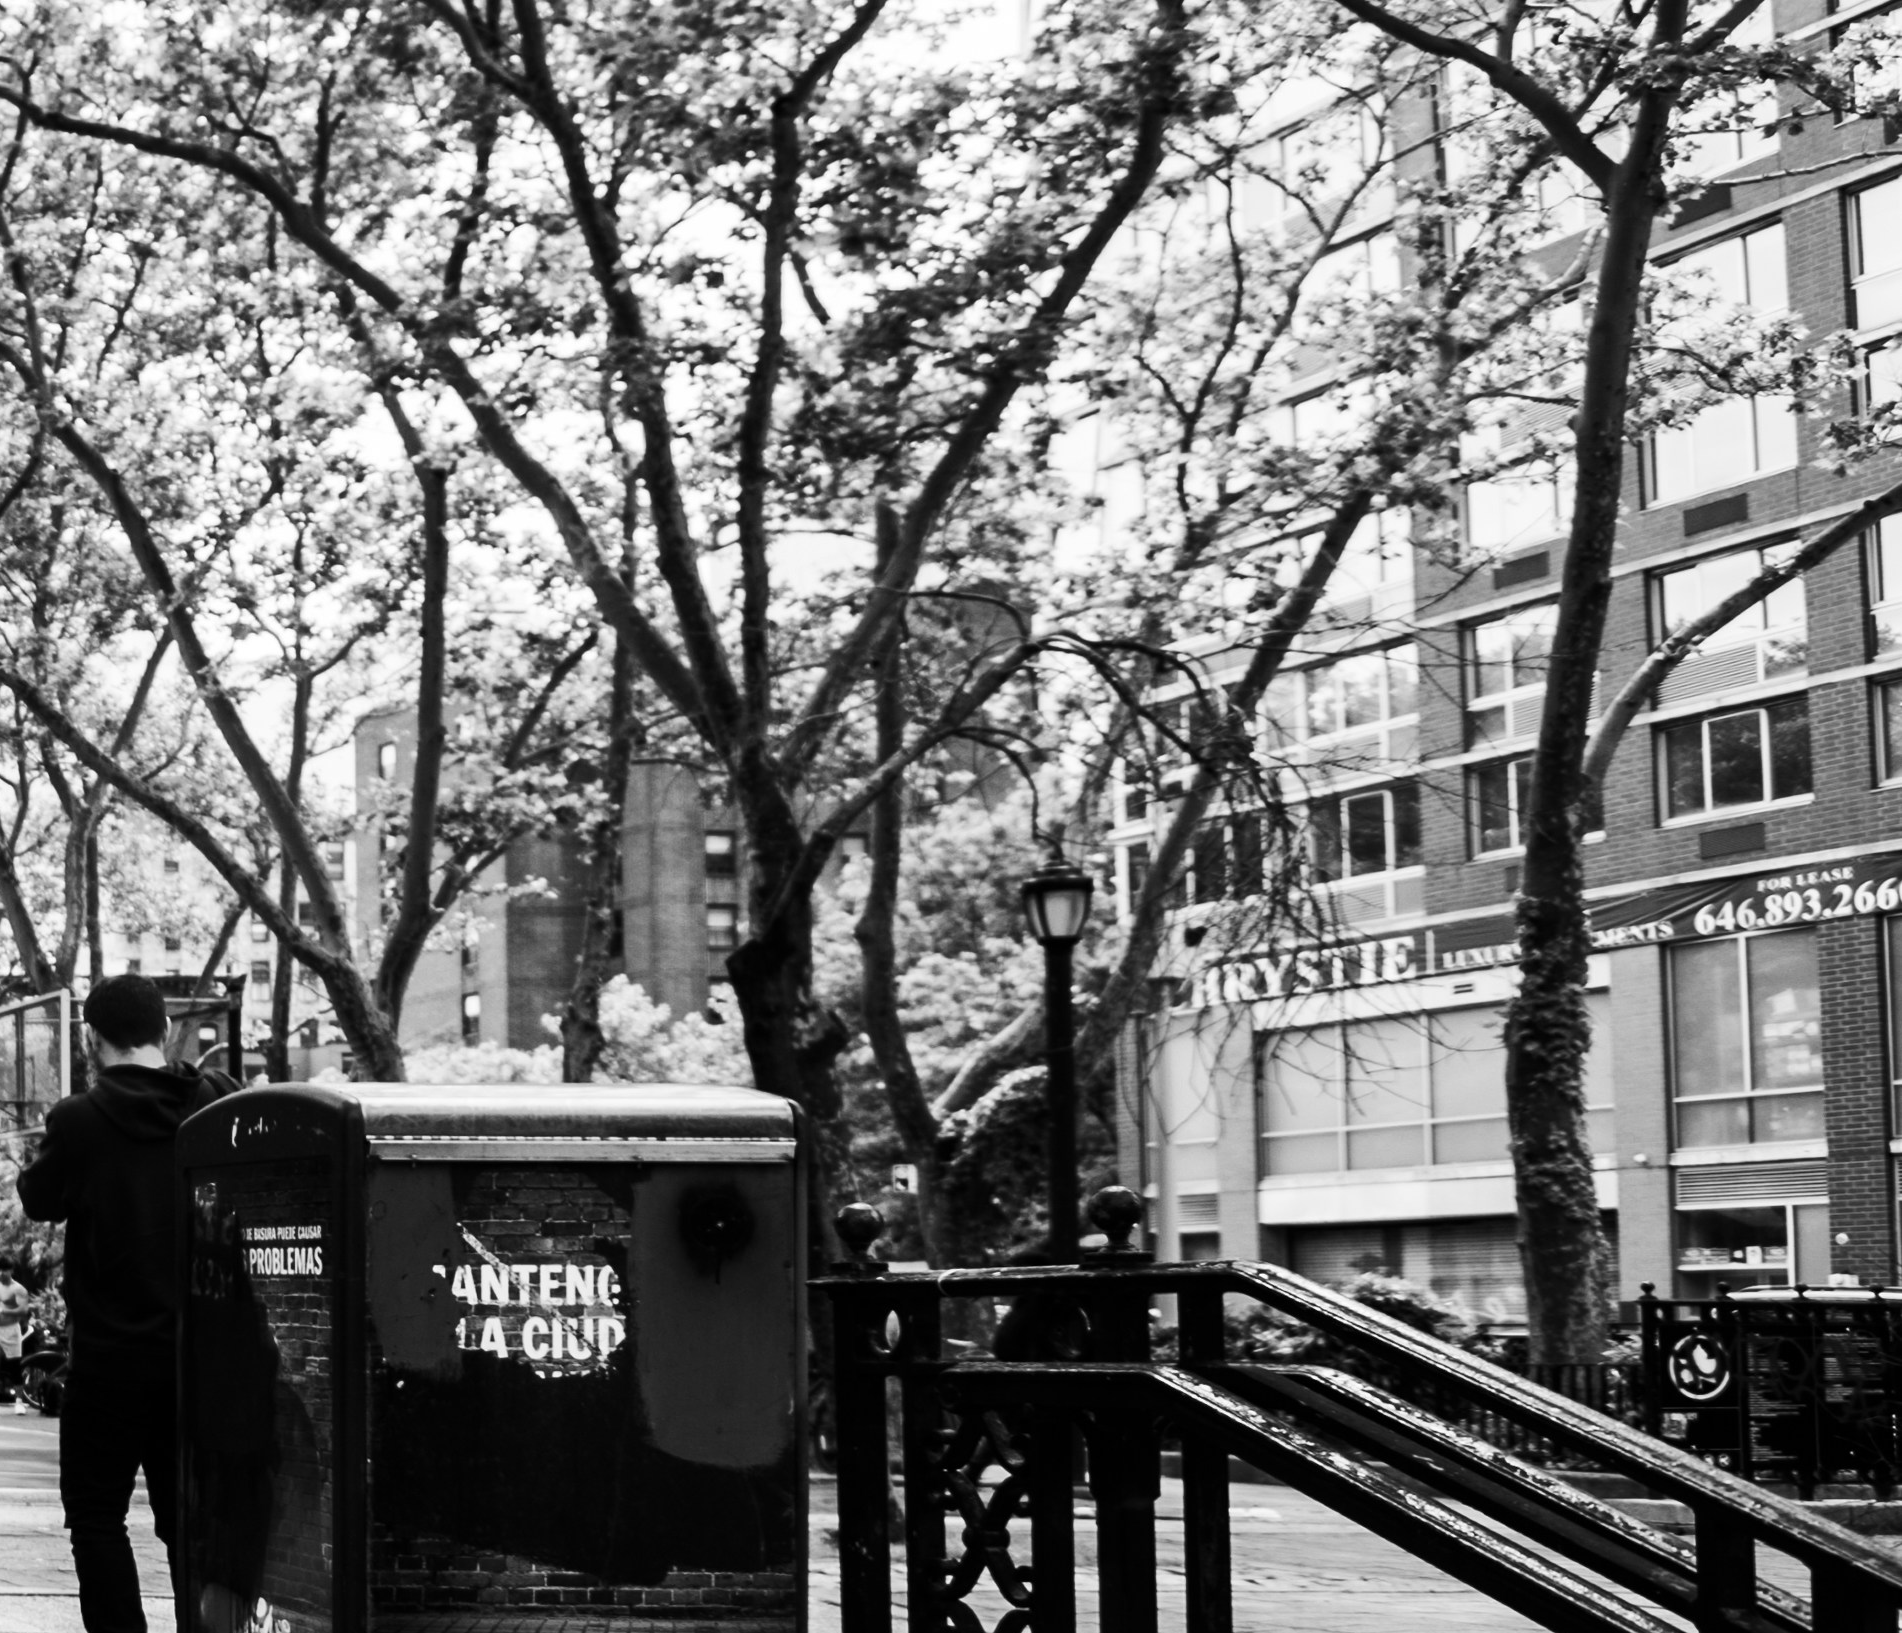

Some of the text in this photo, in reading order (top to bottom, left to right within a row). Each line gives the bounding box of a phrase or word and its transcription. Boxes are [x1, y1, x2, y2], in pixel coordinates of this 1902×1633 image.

[1756, 866, 1856, 893] FOR LEASE
[1694, 876, 1902, 936] 646.893.266
[1589, 920, 1674, 947] MENTS
[297, 1224, 322, 1239] CAUSAR
[249, 1246, 323, 1275] PROBLEMAS
[432, 1264, 621, 1306] ANTENG
